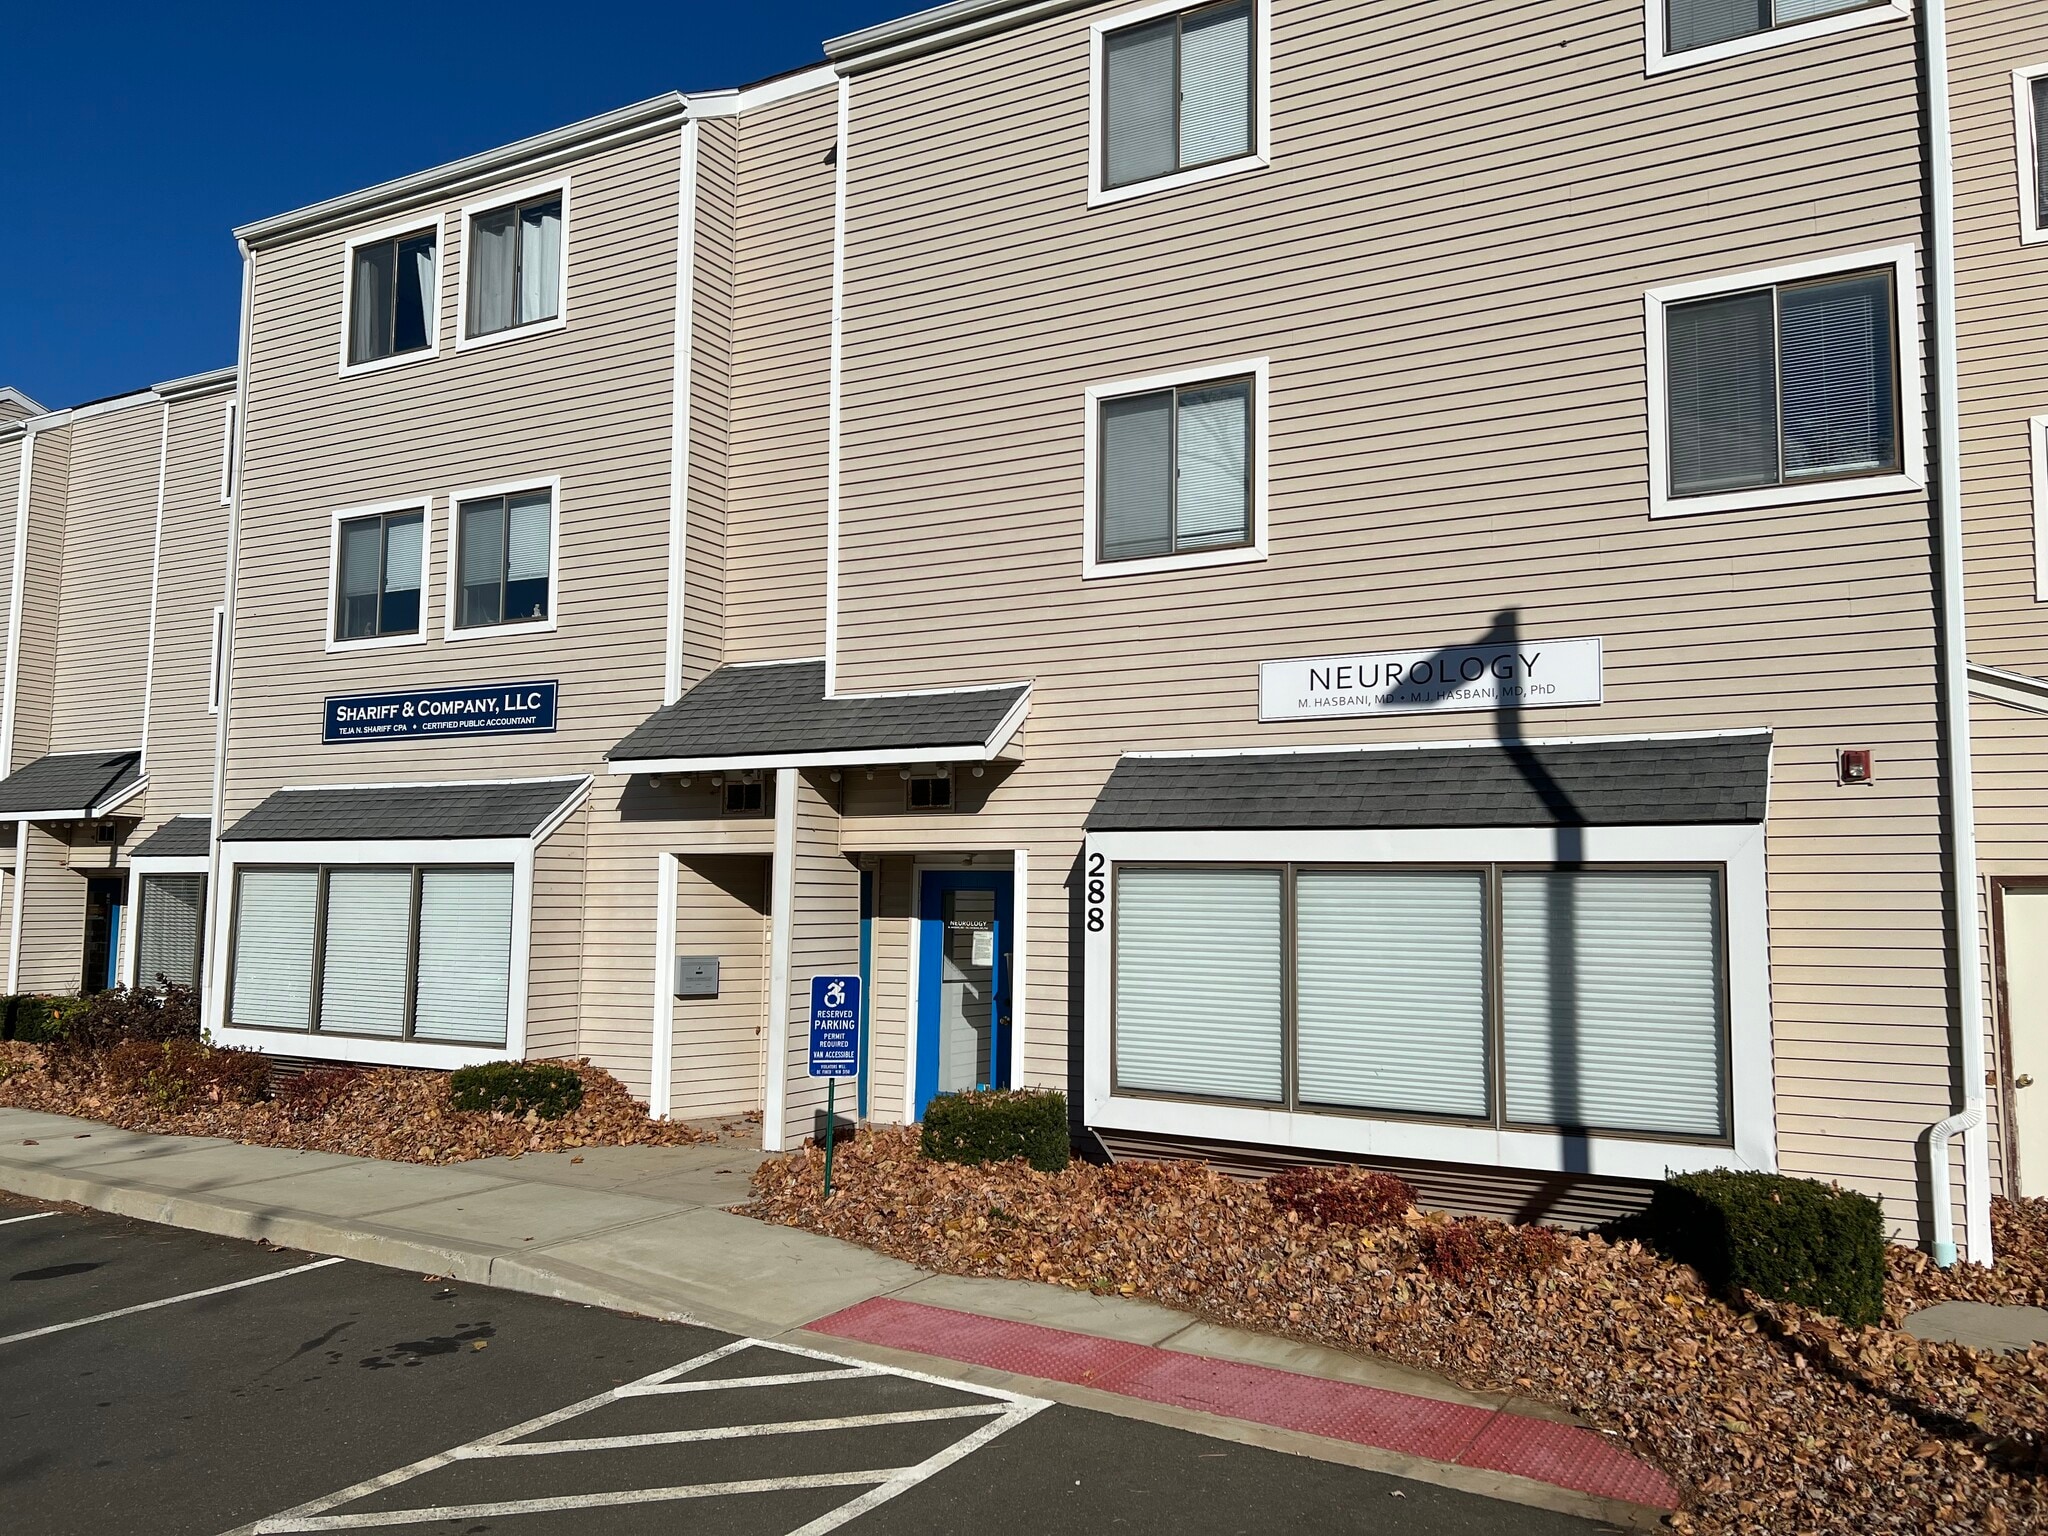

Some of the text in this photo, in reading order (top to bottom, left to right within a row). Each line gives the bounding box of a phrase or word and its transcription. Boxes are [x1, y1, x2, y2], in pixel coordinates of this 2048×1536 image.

[1310, 652, 1541, 691] NEUROLOGY
[1298, 699, 1311, 708] M.
[1314, 695, 1371, 707] HASBANI,
[1374, 693, 1394, 704] MD
[1437, 687, 1499, 701] HASBANI,
[1502, 685, 1527, 698] MD,
[1530, 684, 1556, 695] PhD
[336, 692, 542, 722] SHARIFF & COMPANY, LLC
[339, 716, 537, 735] TEJA N. SHARIFF CPA CERTIFIED PUBLIC ACCOUNTANT
[1087, 852, 1105, 932] 288
[817, 1010, 853, 1018] RESERVED
[814, 1020, 855, 1030] PARKING
[825, 1050, 854, 1058] ACCESSIBLE
